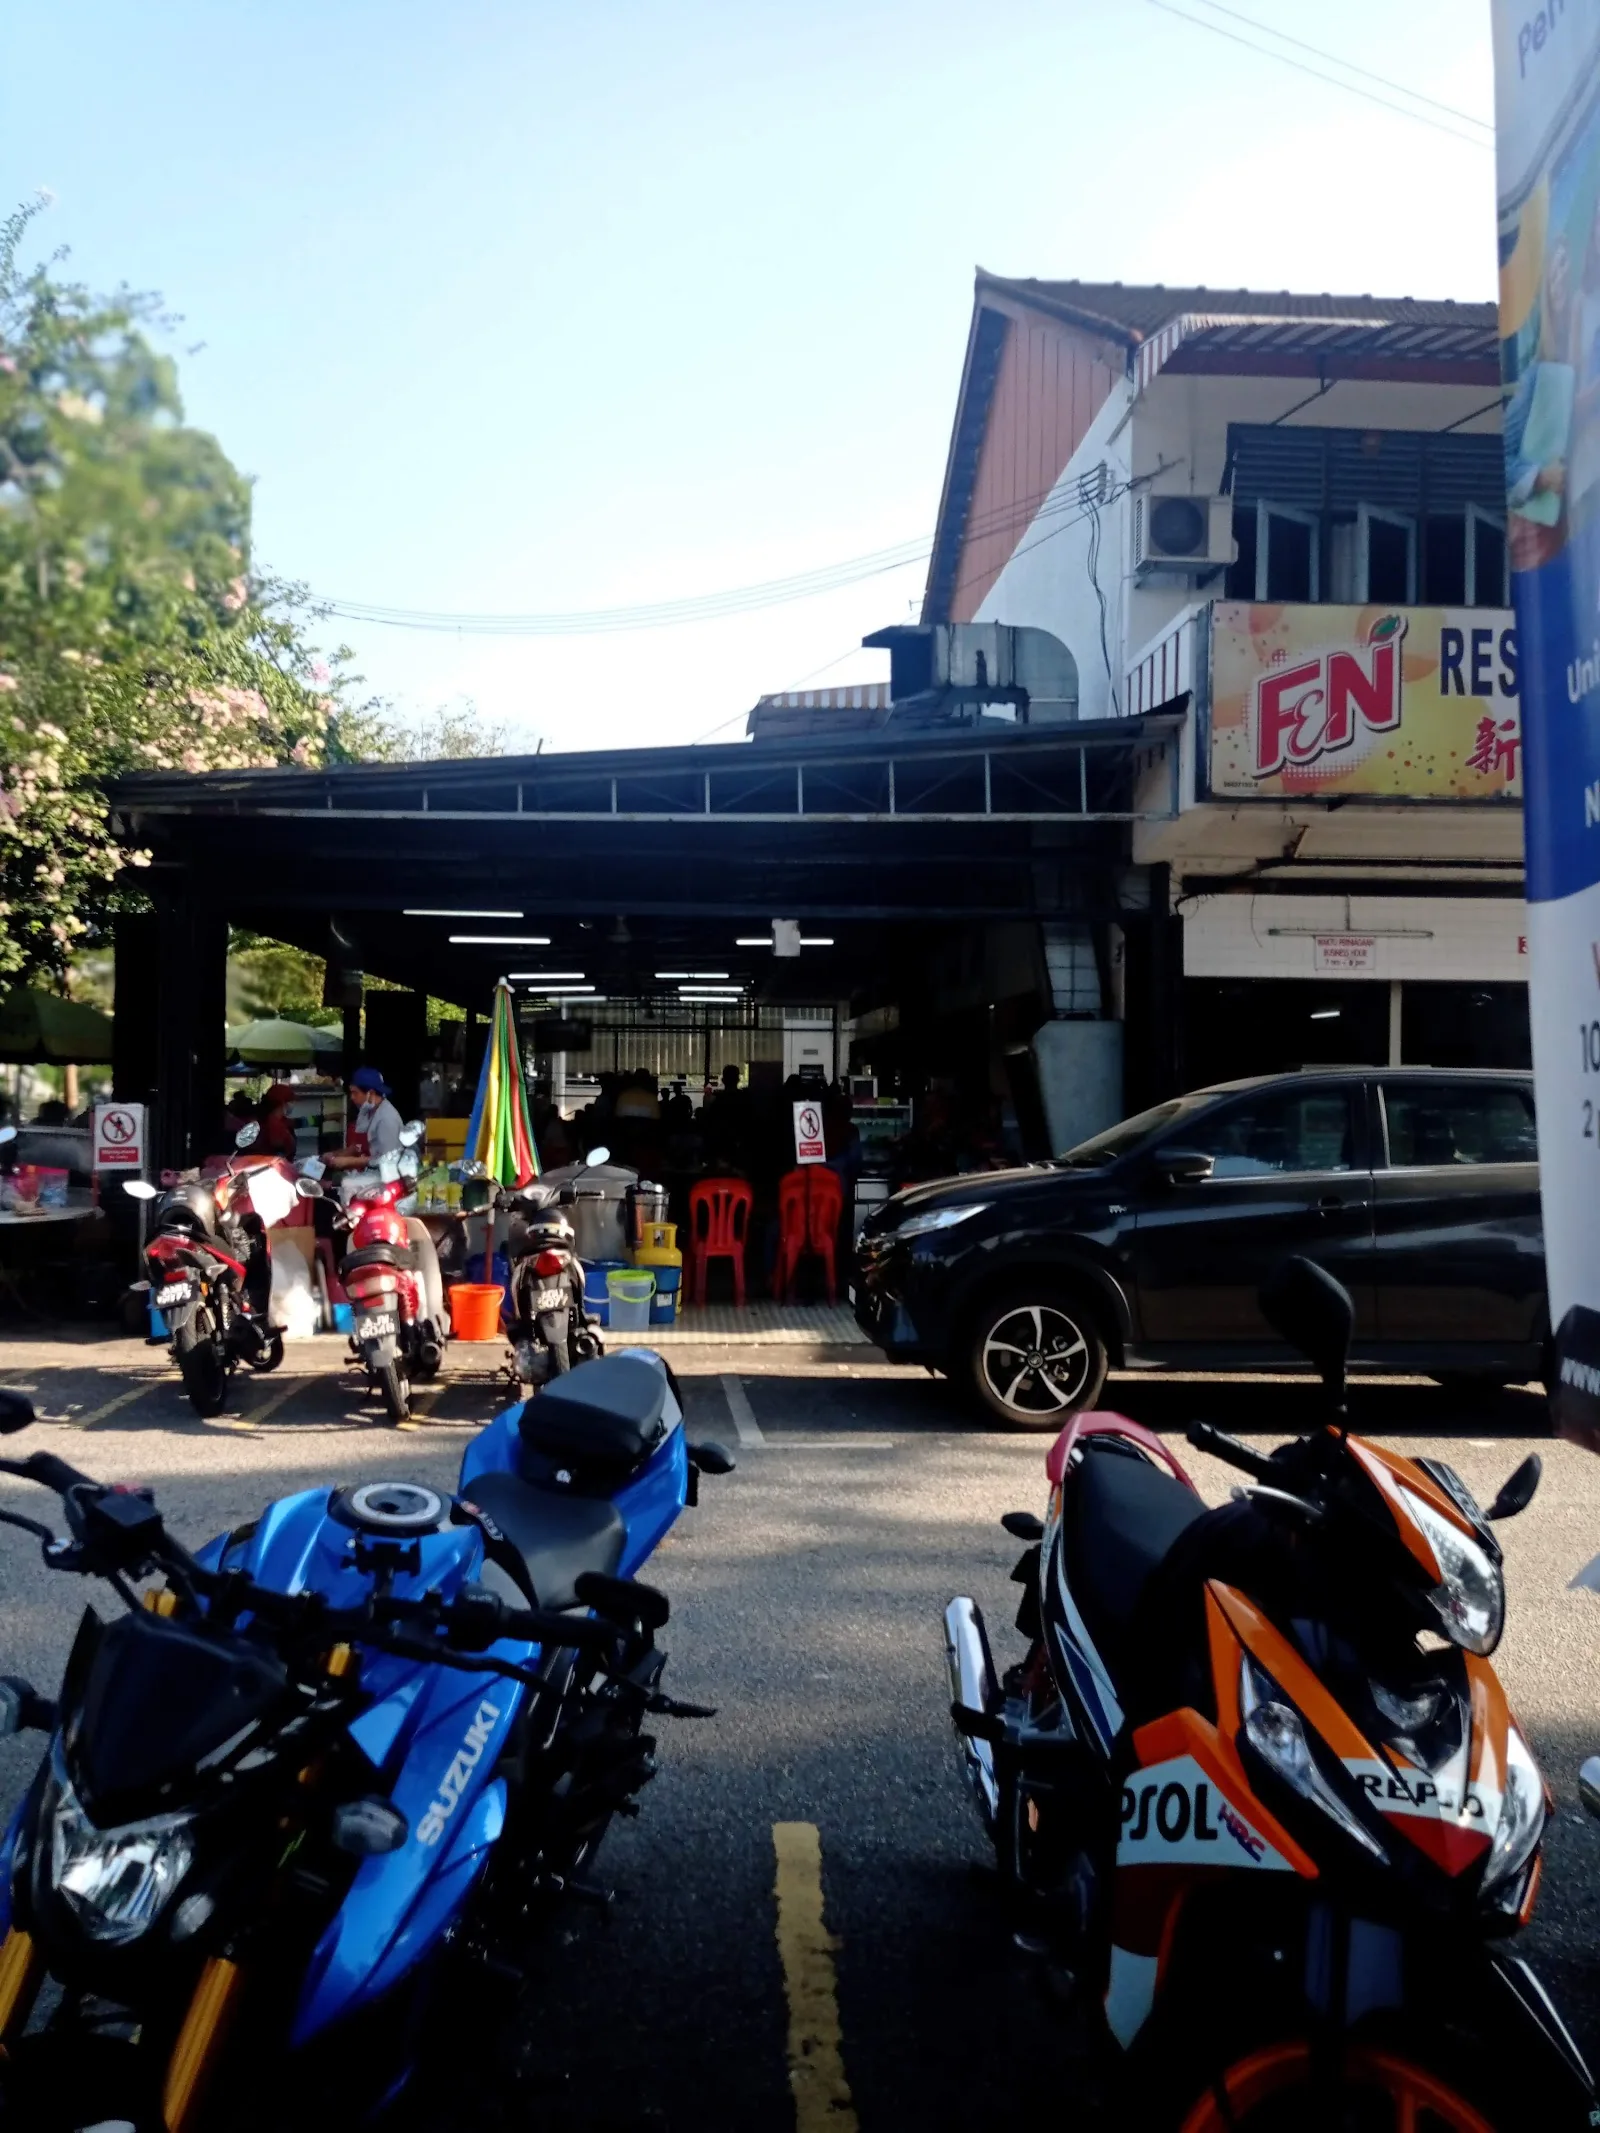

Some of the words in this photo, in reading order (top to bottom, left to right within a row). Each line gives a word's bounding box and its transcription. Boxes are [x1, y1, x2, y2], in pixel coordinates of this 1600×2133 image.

[1256, 640, 1396, 772] F&N
[1441, 628, 1520, 697] RES
[416, 1699, 500, 1846] SUZUKI
